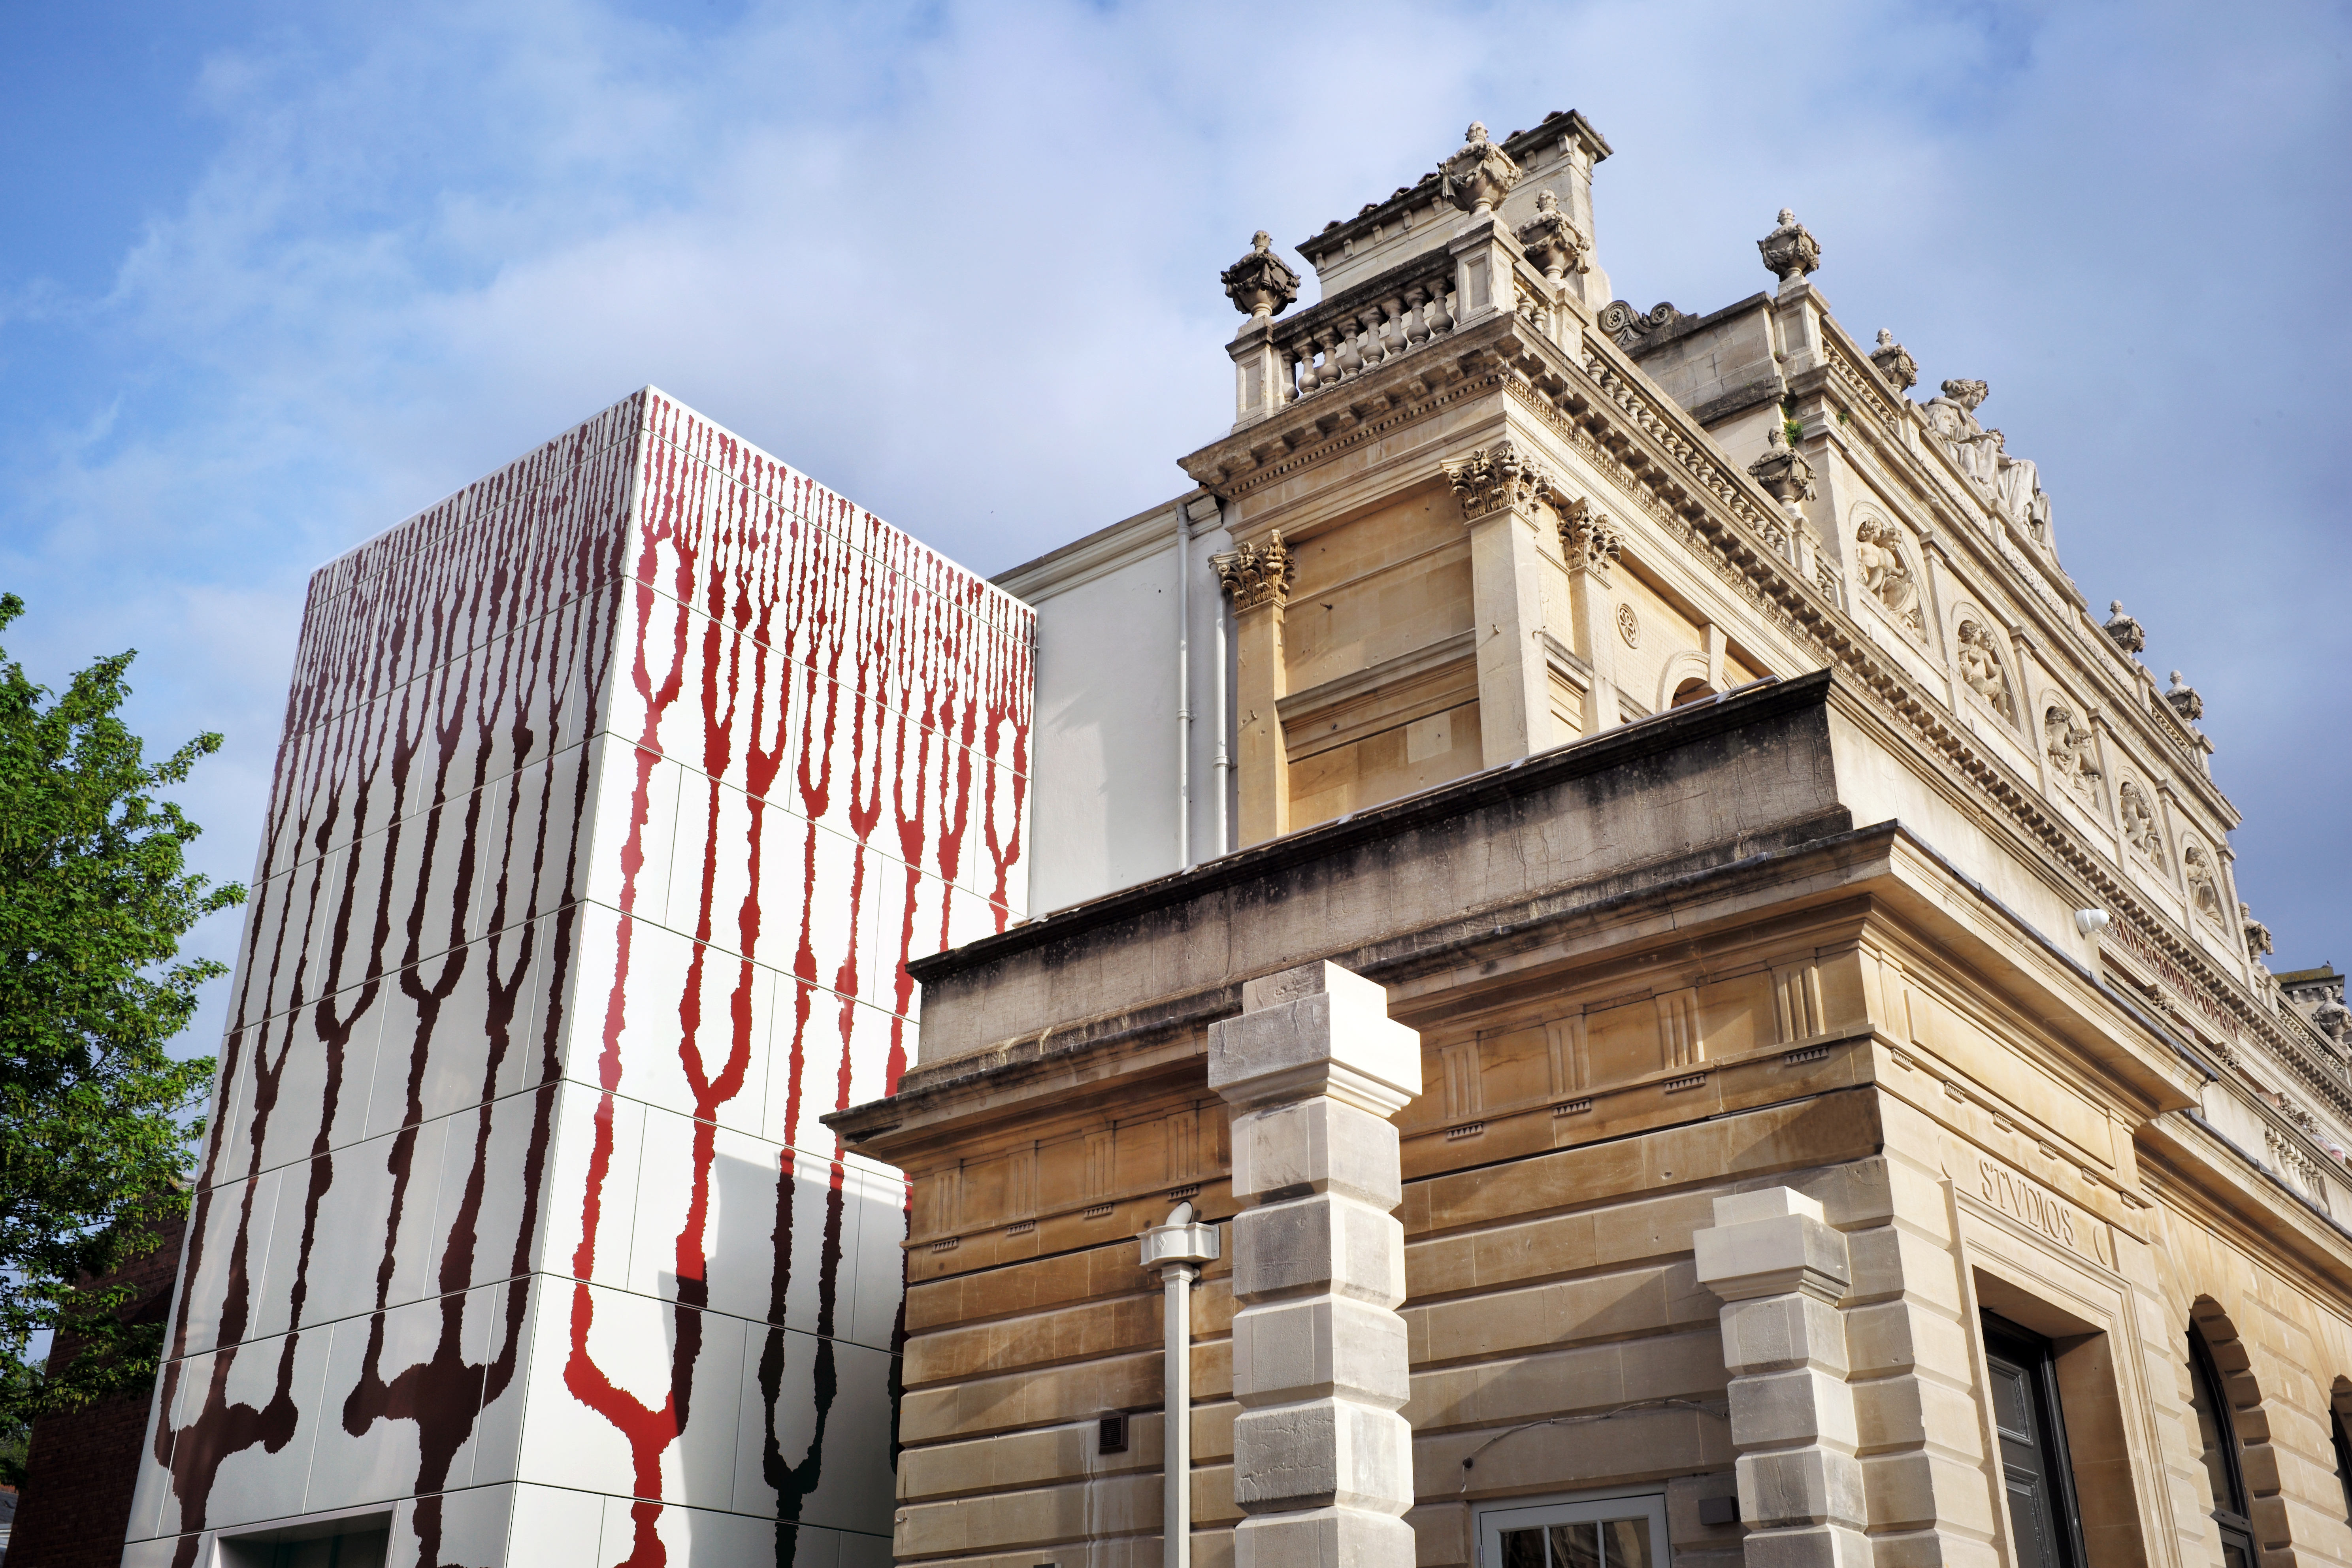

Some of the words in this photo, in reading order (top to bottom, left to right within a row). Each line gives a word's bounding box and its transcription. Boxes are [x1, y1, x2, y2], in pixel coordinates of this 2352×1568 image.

[2143, 941, 2198, 1006] ACADEMY
[2201, 995, 2216, 1020] OF
[2219, 1007, 2239, 1041] ART
